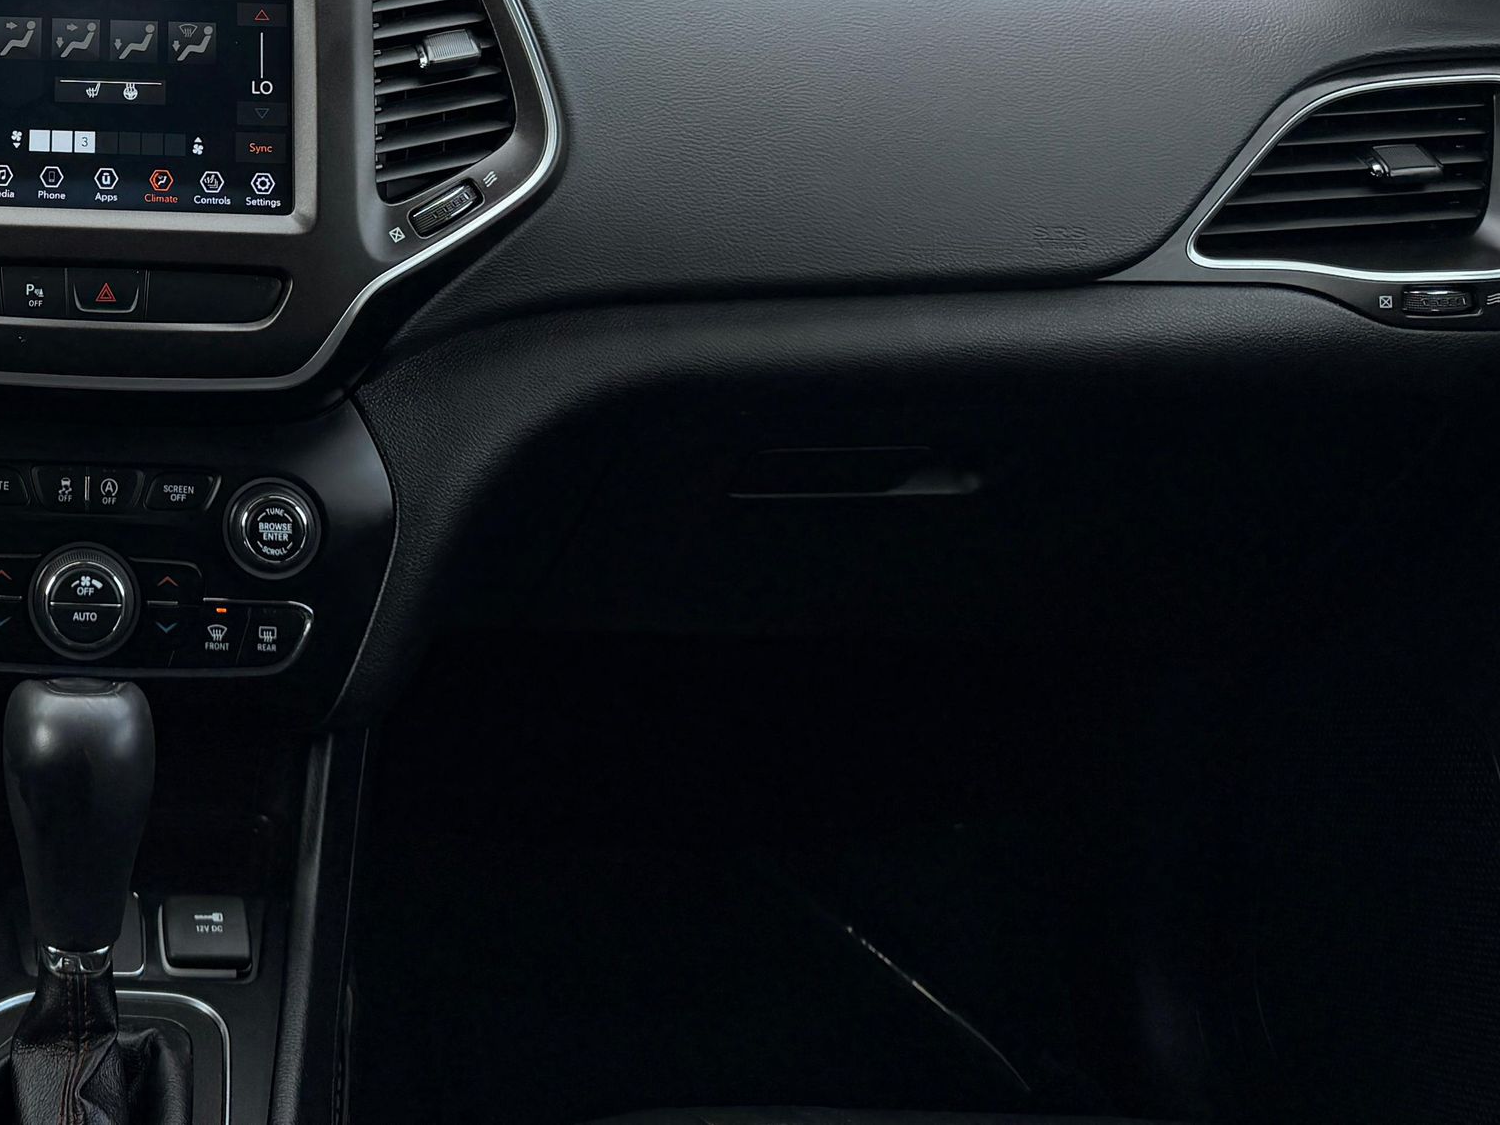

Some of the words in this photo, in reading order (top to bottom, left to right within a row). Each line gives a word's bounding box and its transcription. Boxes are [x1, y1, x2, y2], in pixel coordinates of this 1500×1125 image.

[251, 81, 273, 95] LO
[80, 136, 89, 148] 3
[249, 143, 273, 155] Sync
[38, 190, 66, 200] Phone
[94, 192, 118, 202] Apps
[144, 193, 178, 203] Climate
[193, 195, 231, 205] Controls
[245, 197, 281, 208] Settings
[163, 485, 195, 494] SCREEN
[58, 495, 72, 503] OFF
[102, 497, 117, 505] OFF
[170, 494, 187, 502] OFF
[265, 507, 285, 517] TUNE
[259, 522, 292, 531] BROWSE
[263, 533, 288, 542] ENTER
[262, 546, 288, 556] SCROLL
[76, 587, 94, 596] OFF
[73, 612, 97, 622] AUTO
[205, 642, 229, 651] FRONT
[257, 643, 277, 652] REAR
[196, 925, 209, 933] 12V
